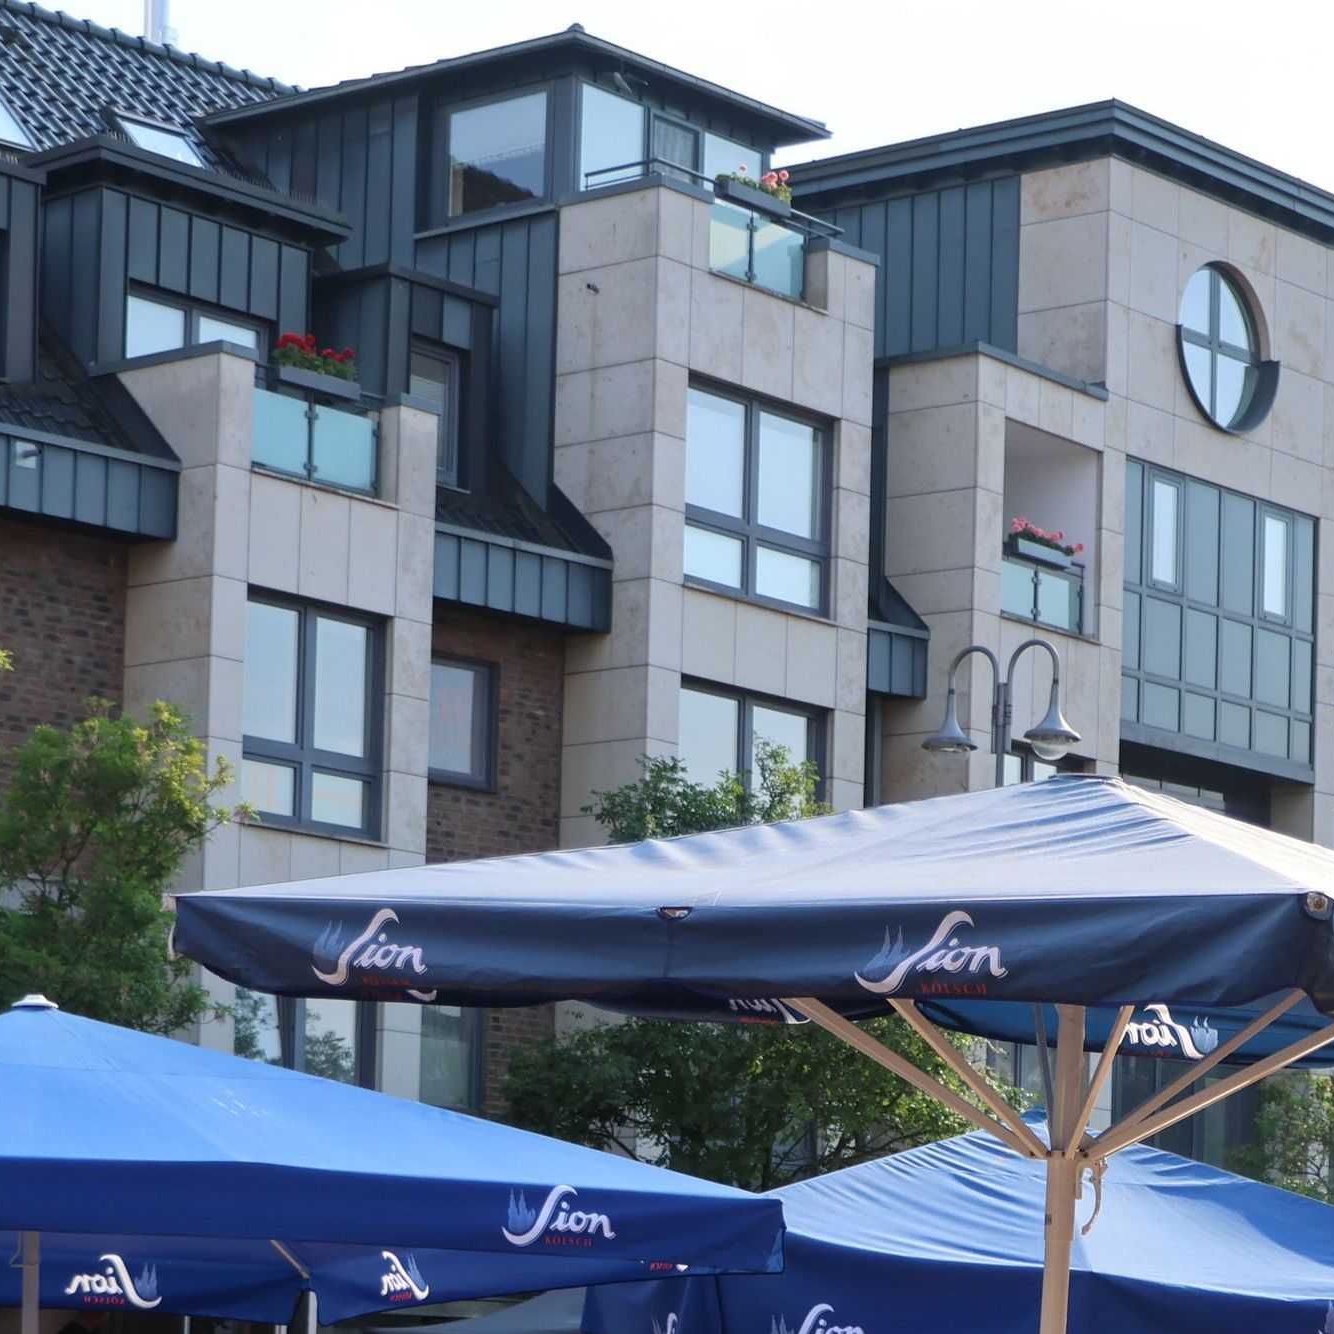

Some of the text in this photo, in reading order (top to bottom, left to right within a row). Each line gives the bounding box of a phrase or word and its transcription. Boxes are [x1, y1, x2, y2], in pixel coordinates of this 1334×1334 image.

[312, 908, 428, 986] Sion
[855, 910, 1007, 994] Sion
[502, 1184, 617, 1247] Sion
